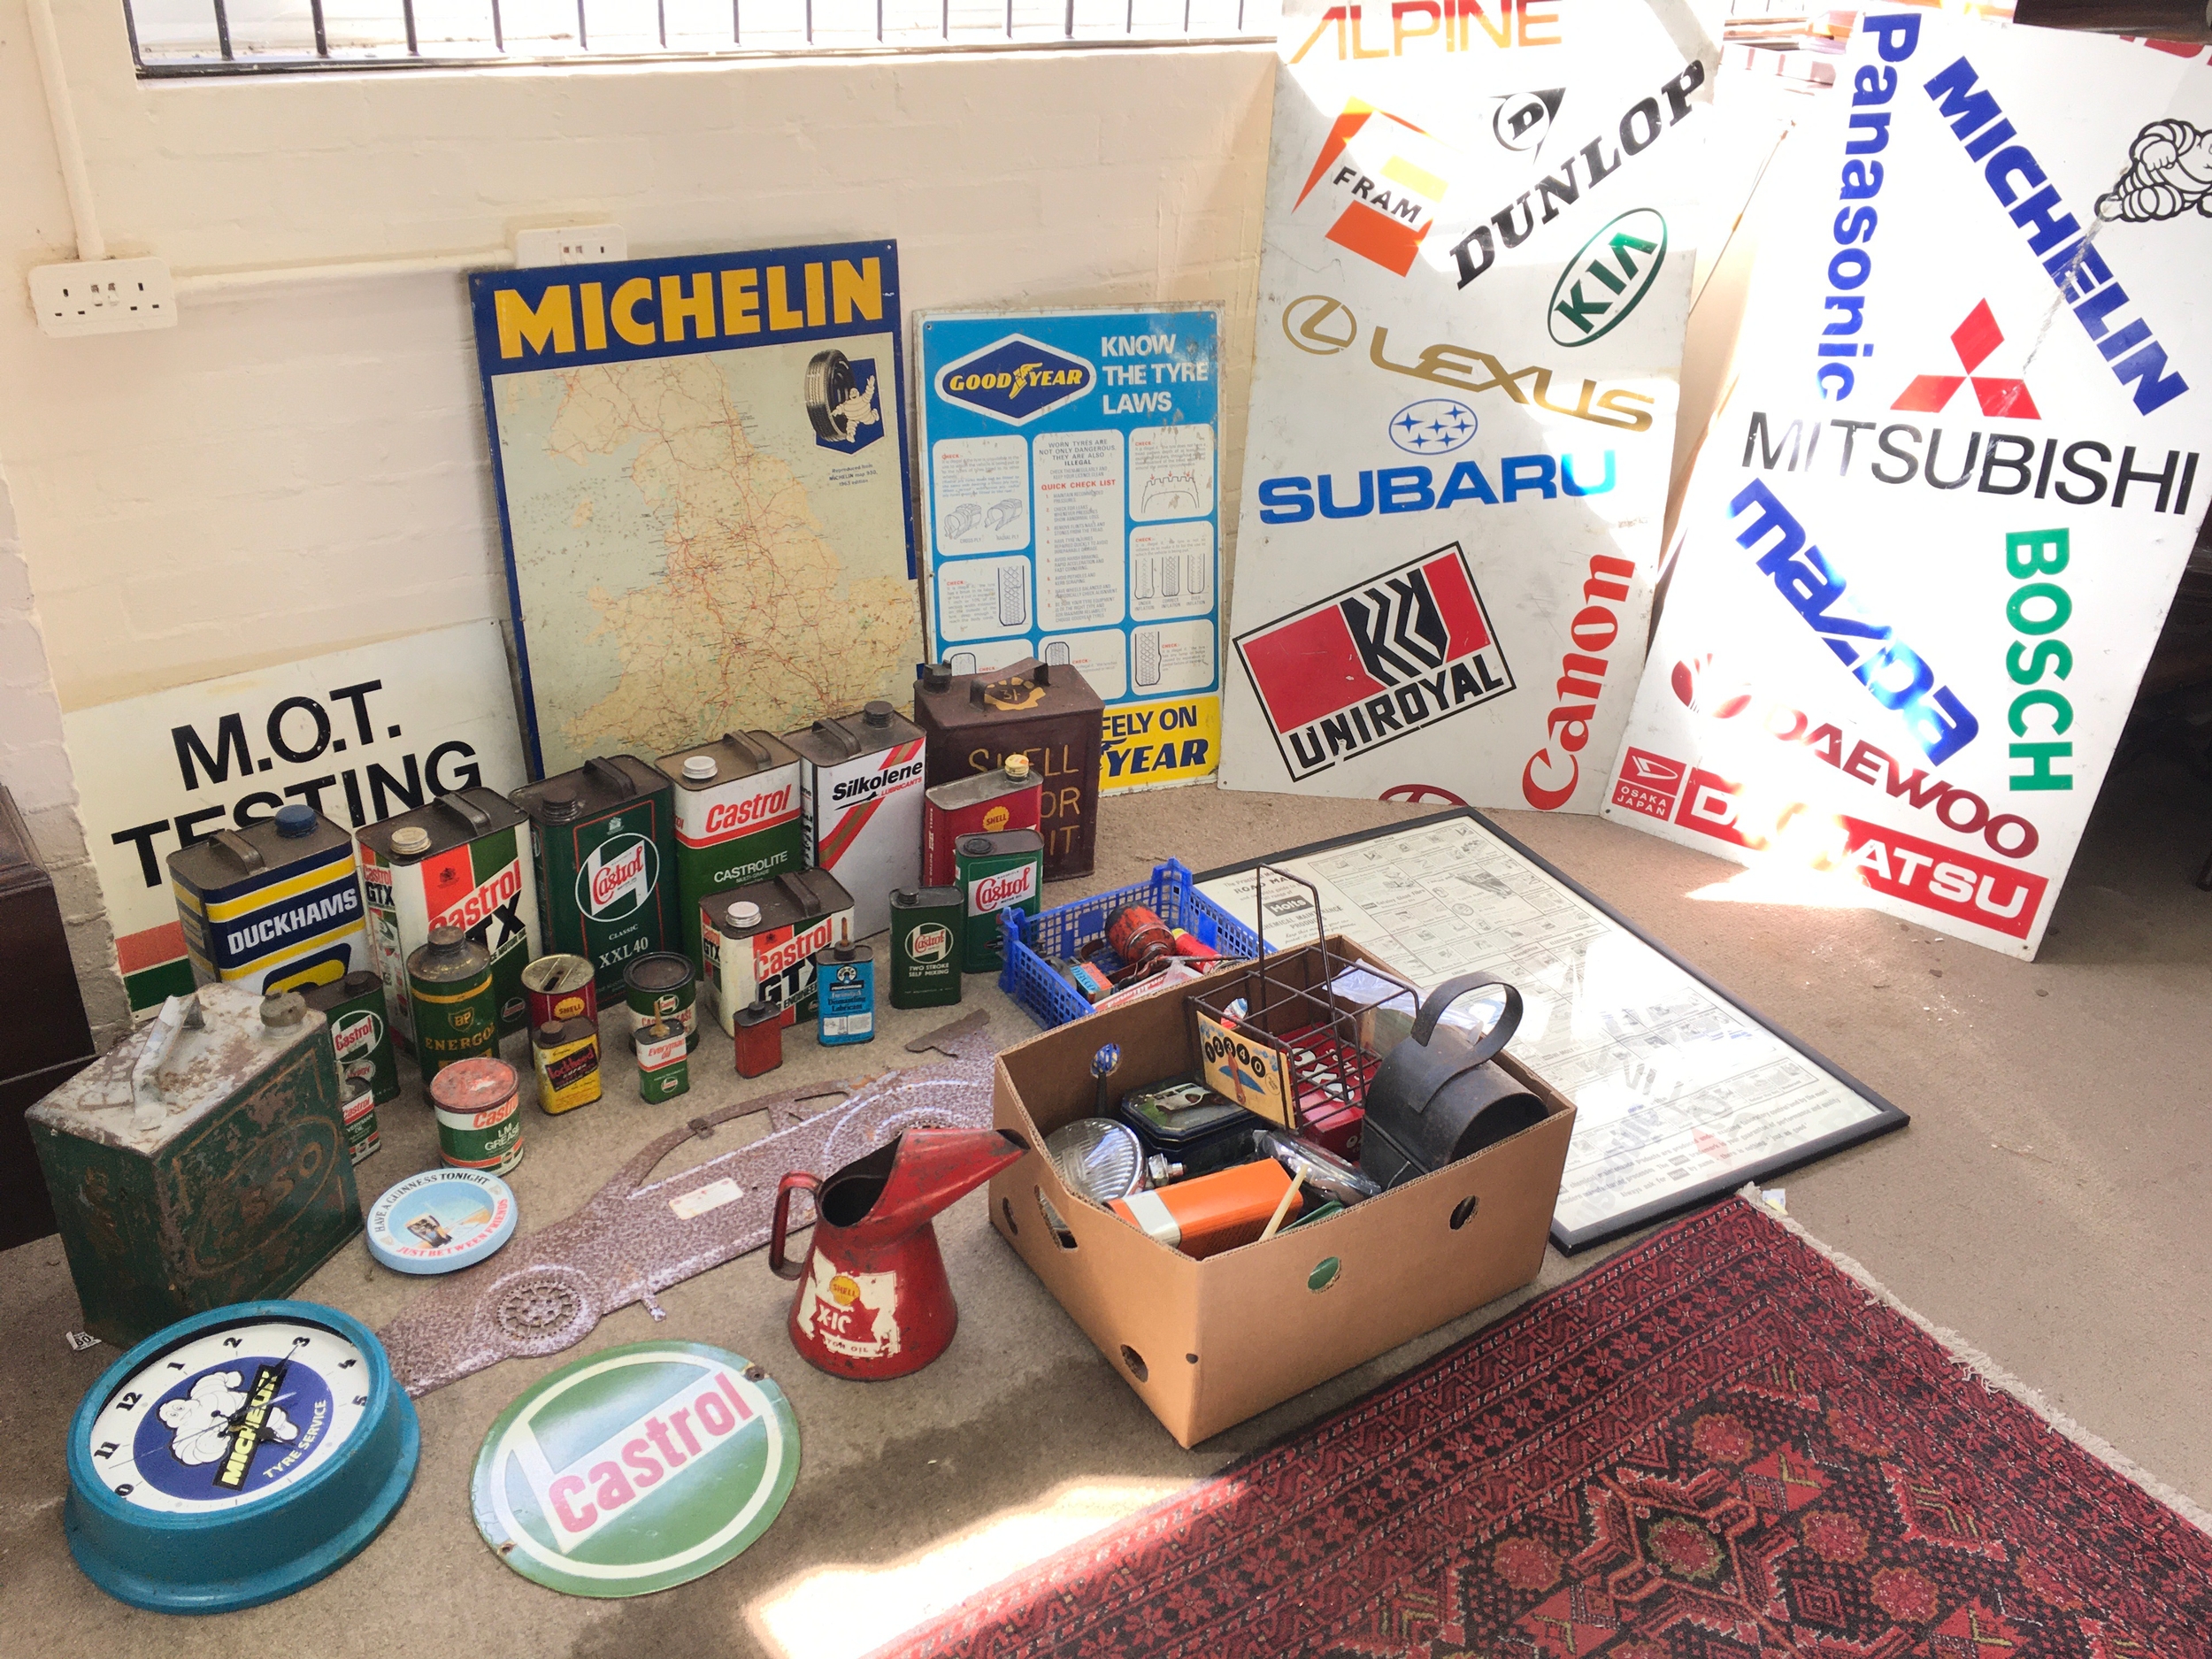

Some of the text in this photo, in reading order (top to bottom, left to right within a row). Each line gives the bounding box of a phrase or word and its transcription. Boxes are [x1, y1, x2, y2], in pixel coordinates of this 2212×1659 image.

[1287, 0, 1562, 64] ALPINE
[1449, 59, 1706, 291] DUNLOP
[1333, 165, 1423, 225] FRAM
[1817, 12, 1922, 402] Panasonic
[1923, 56, 2190, 416] MICHELIN
[1554, 232, 1659, 335] KIA
[494, 257, 883, 359] MICHELIN
[1101, 334, 1177, 357] KNOW
[1102, 362, 1209, 386] THE TYRE
[1370, 326, 1655, 433] LEXUS
[1102, 391, 1172, 415] LAWS
[1742, 411, 2200, 516] MITSUBISHI
[1258, 449, 1616, 525] SUBARU
[2005, 527, 2073, 791] BOSCH
[1522, 554, 1636, 810] Canon
[1159, 705, 1197, 731] ON
[1289, 655, 1503, 769] UNIROYAL
[172, 680, 402, 791] M.O.T.
[832, 761, 923, 802] Silkolene
[881, 776, 923, 797] LUBRICANTS
[1621, 786, 1666, 807] OSAKA
[705, 784, 792, 833] Castrol
[987, 813, 1007, 826] SHELL
[1617, 795, 1665, 816] JAPAN
[593, 846, 643, 904] Castrol
[714, 851, 788, 883] CASTROLITE
[365, 881, 395, 906] GTX
[429, 859, 522, 932] Castrol
[975, 866, 1031, 912] Castrol
[1270, 898, 1307, 913] Holts
[1296, 906, 1344, 924] MAINTNANCE
[227, 887, 357, 955] DUCKHAMS
[609, 924, 638, 941] CLASSIC
[1290, 917, 1327, 930] PRODUCS
[754, 917, 833, 982] Castrol
[915, 930, 945, 953] Castrol
[454, 1011, 471, 1026] BP
[559, 1003, 582, 1015] SHELL
[334, 1017, 373, 1051] Castrol
[343, 1096, 370, 1118] Castrol
[485, 1122, 519, 1151] GREASE
[498, 1123, 512, 1138] LM
[374, 1211, 387, 1233] HAVE
[386, 1175, 438, 1206] GUINNESS
[440, 1172, 490, 1186] TONIGHT
[396, 1198, 508, 1257] JUST BETWEEN FRIENDS
[833, 1283, 856, 1296] SHELL
[223, 1337, 242, 1348] 2
[293, 1337, 311, 1347] 3
[167, 1362, 186, 1371] 1
[116, 1392, 142, 1411] 12
[352, 1395, 368, 1406] 5
[94, 1442, 121, 1460] 11
[263, 1400, 326, 1478] TYRE SERVICE
[549, 1372, 754, 1533] Castrol
[116, 1484, 134, 1499] 0
